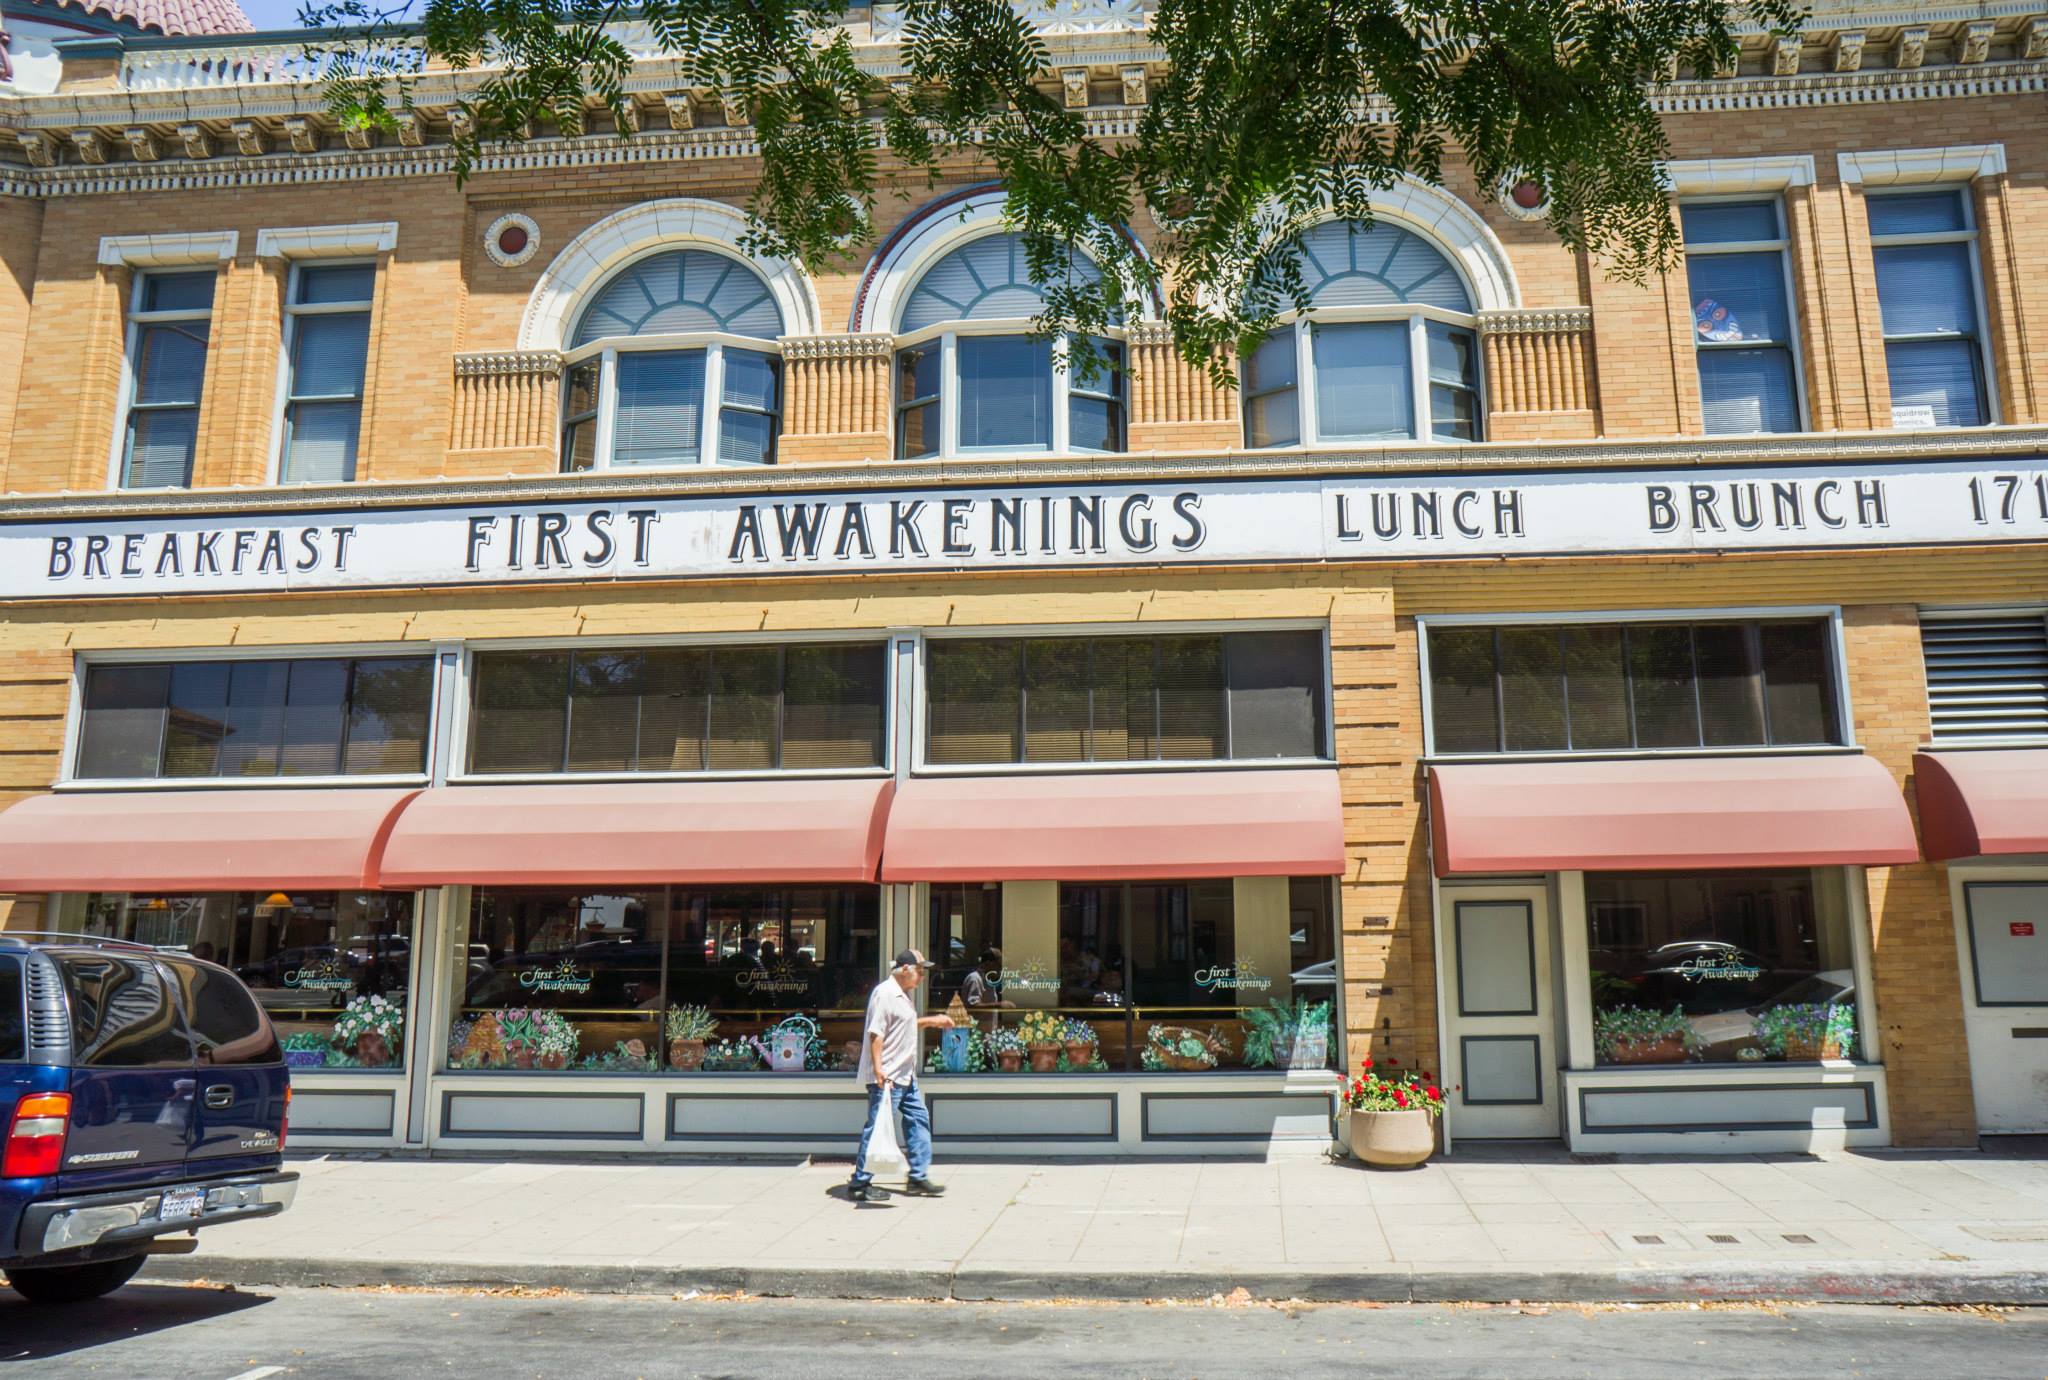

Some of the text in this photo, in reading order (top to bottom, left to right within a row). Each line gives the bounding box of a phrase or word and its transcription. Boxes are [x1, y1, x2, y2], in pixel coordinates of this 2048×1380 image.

[1647, 479, 1889, 534] BRUNCH
[1336, 488, 1525, 541] LUNCH
[465, 492, 1207, 571] FIRST AWAKENINGS
[48, 527, 356, 580] BREAKFAST
[1697, 969, 1759, 983] Awakenings
[296, 979, 352, 993] Awakenings
[531, 980, 591, 995] Awakenings
[748, 981, 809, 995] Awakenings
[1001, 980, 1061, 993] Awakenings
[1209, 978, 1272, 993] Awakenings
